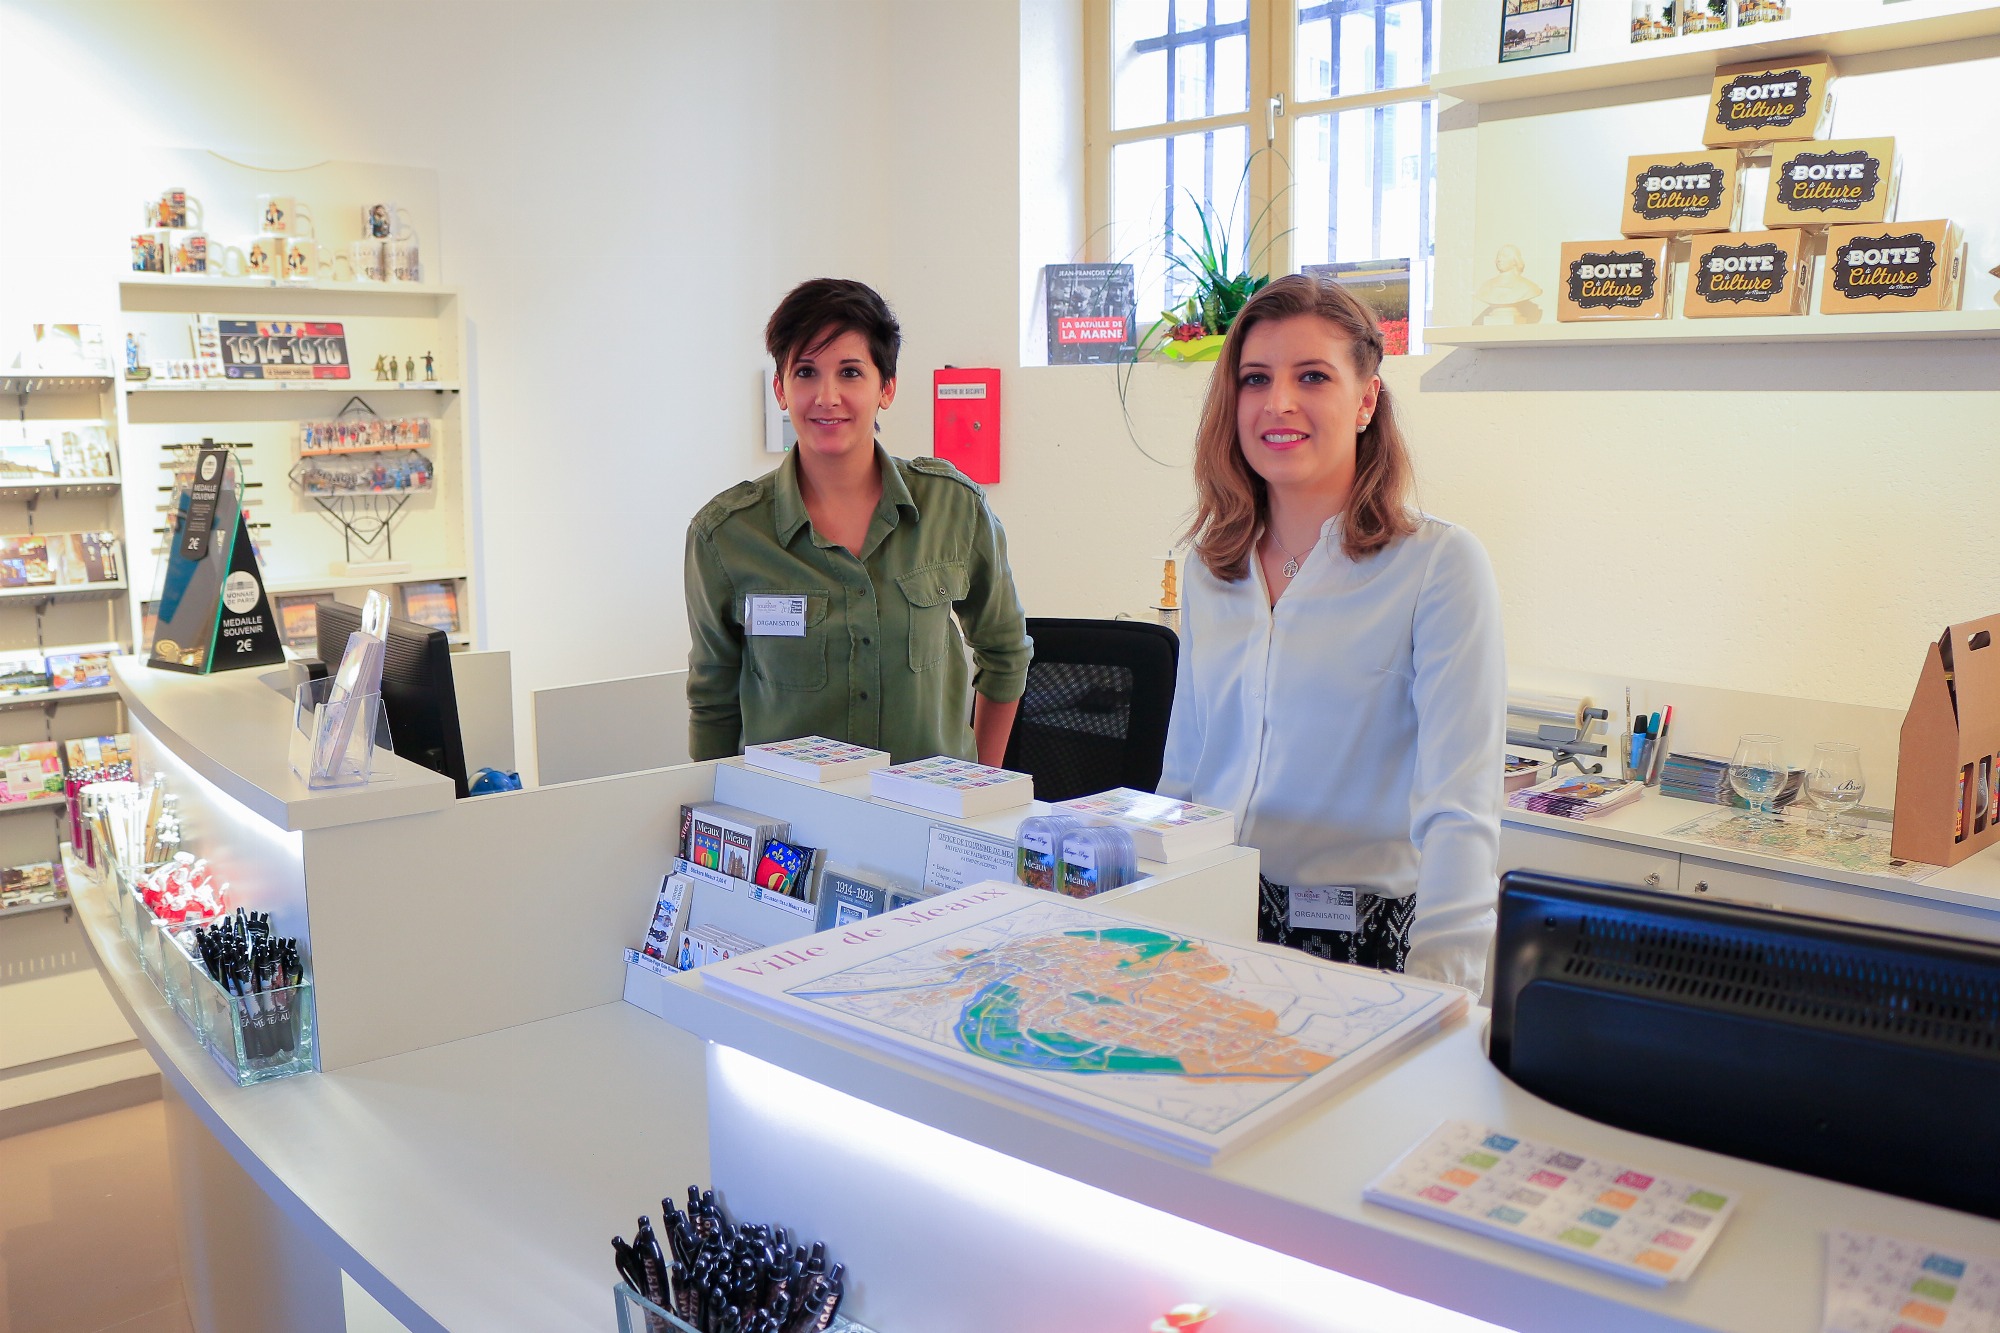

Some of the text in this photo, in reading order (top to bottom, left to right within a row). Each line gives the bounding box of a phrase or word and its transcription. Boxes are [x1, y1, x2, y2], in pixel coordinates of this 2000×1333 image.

[1731, 81, 1798, 102] BOITE
[1731, 101, 1795, 119] Culture
[1792, 163, 1865, 180] BOITE
[1646, 173, 1711, 192] BOITE
[1793, 181, 1862, 199] Culture
[1647, 192, 1710, 209] Culture
[1710, 255, 1775, 272] BOITE
[1848, 246, 1920, 266] BOITE
[1580, 263, 1643, 279] BOITE
[1849, 267, 1918, 286] Culture
[1582, 280, 1642, 297] Culture
[1710, 273, 1772, 291] Culture
[1075, 321, 1110, 329] BATAILLE
[1062, 329, 1123, 340] LA MARNE
[226, 336, 342, 365] 1914-1918
[226, 591, 254, 599] MONNAIE
[223, 616, 263, 627] MEDAILLE
[223, 625, 263, 637] SOUVENIR
[236, 638, 253, 653] 2€
[696, 821, 720, 838] Meaux
[725, 830, 749, 847] Meaux
[1023, 858, 1047, 872] Meaux
[1064, 873, 1089, 887] Meaux
[836, 880, 874, 902] 1914-1918
[1294, 910, 1351, 921] ORGANISATION
[733, 946, 829, 977] Ville
[842, 927, 887, 945] de
[891, 888, 1008, 927] Meaux
